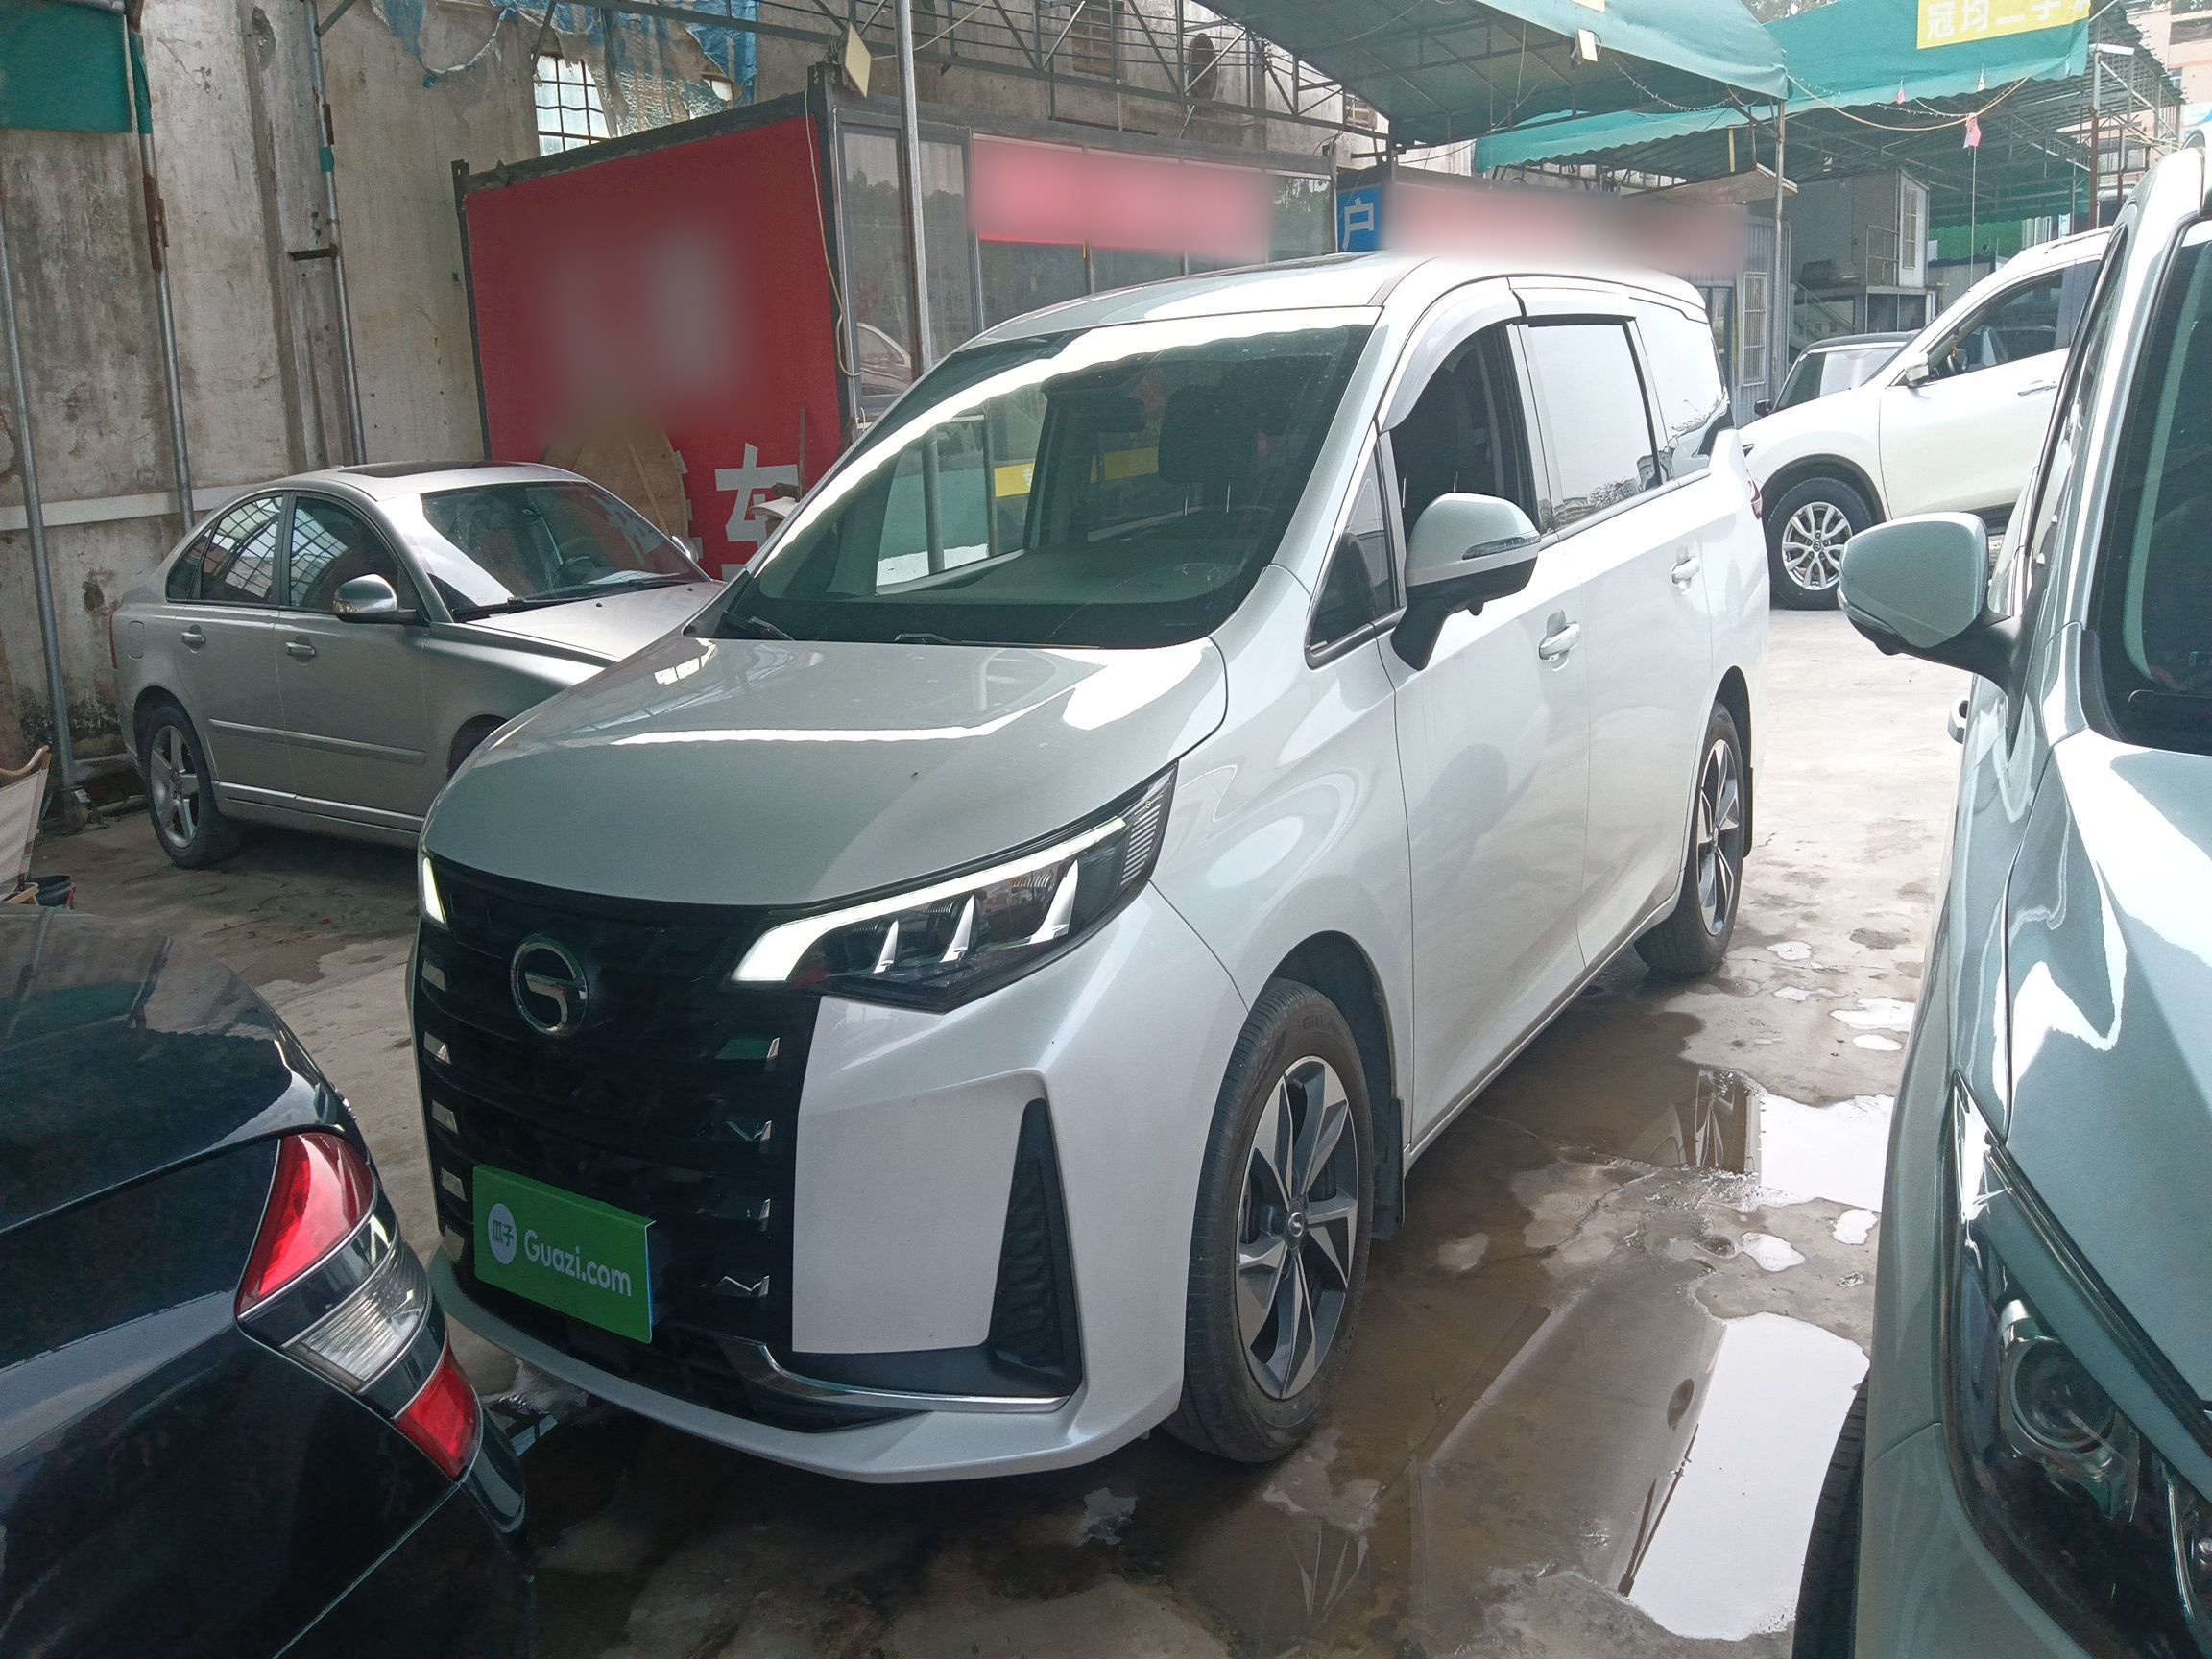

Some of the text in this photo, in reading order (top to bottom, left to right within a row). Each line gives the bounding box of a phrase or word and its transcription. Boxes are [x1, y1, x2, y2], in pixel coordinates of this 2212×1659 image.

[1342, 197, 1374, 252] 户
[492, 1219, 515, 1247] 瓜子
[524, 1228, 632, 1297] Guazi.com
